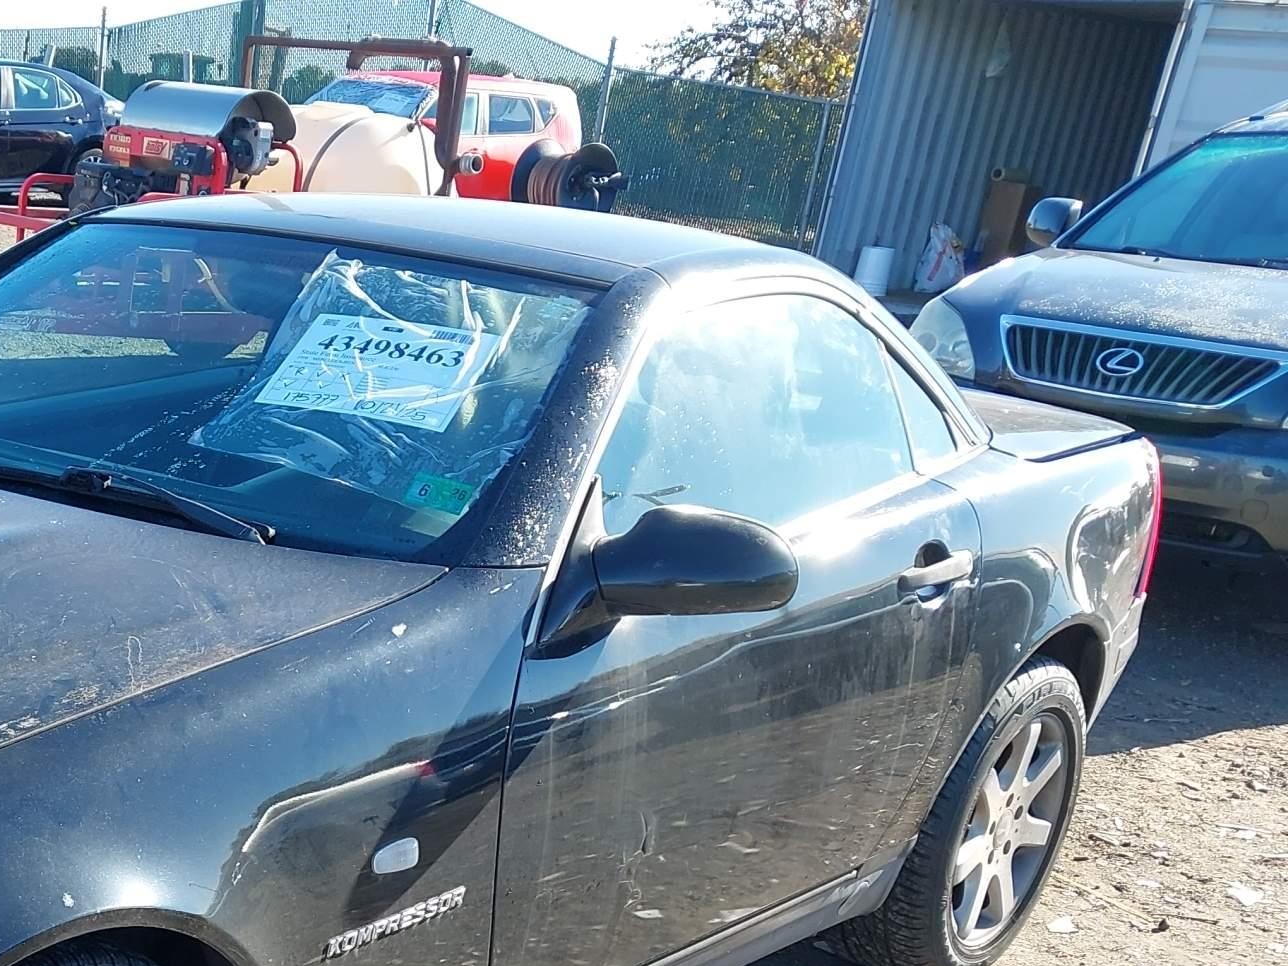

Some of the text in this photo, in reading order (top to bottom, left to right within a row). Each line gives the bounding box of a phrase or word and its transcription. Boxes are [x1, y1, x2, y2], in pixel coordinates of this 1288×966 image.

[318, 334, 462, 367] 43498463
[418, 483, 431, 497] 6
[325, 885, 467, 961] KOMPRESSOR
